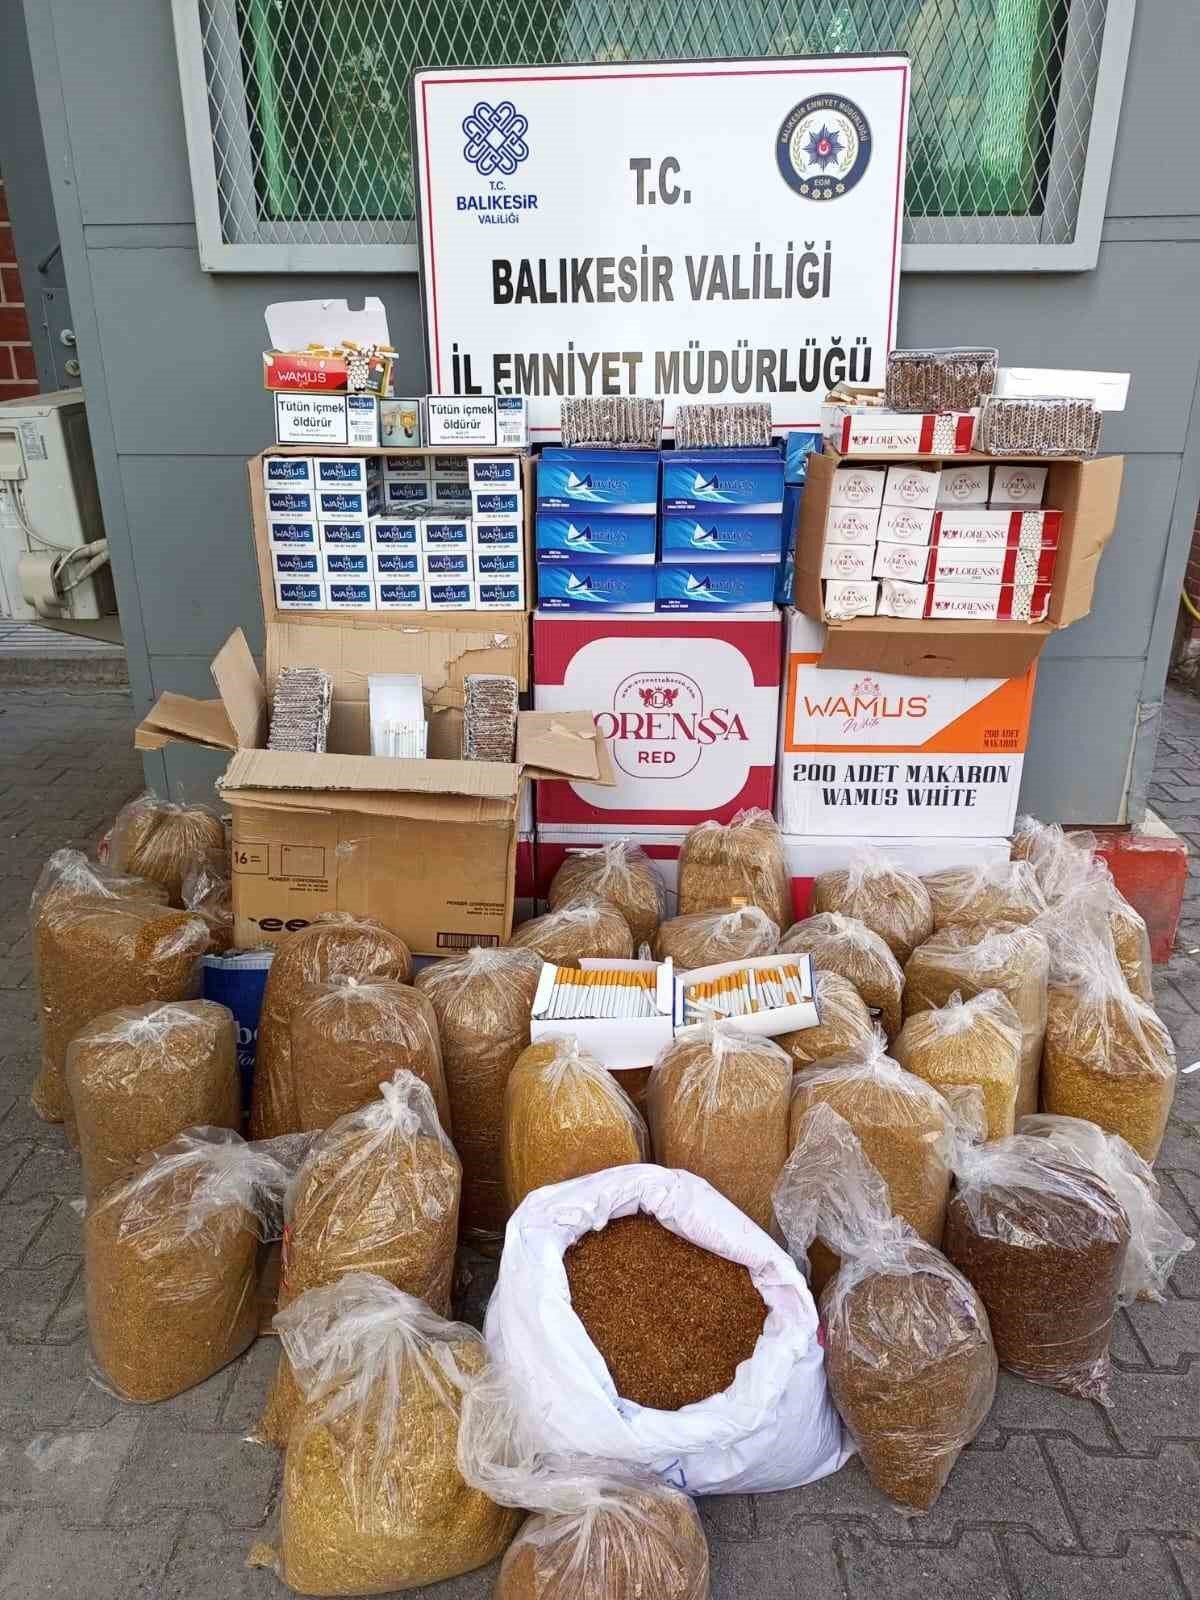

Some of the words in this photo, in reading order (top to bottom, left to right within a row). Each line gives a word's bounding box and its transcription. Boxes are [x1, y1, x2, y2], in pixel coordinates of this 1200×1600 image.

[488, 180, 507, 191] T.C.
[629, 156, 692, 205] T.C.
[491, 244, 674, 304] BALIKESİR
[685, 240, 832, 301] VALİLİĞİ
[452, 342, 482, 395] İL
[493, 341, 643, 395] EMNİYET
[655, 335, 873, 395] MÜDÜRLÜĞÜ
[277, 370, 327, 383] WAMUS
[279, 399, 310, 413] Tütün
[313, 401, 345, 415] içmek
[430, 404, 460, 415] Tütün
[463, 404, 494, 417] içmek
[293, 416, 333, 428] öldürür
[443, 418, 481, 430] öldürür
[270, 468, 306, 477] WAMUS
[321, 469, 358, 478] WAMUS
[476, 470, 512, 478] WAMUS
[271, 499, 308, 509] WAMUS
[322, 500, 359, 509] WAMUS
[479, 500, 514, 509] WAMUS
[274, 530, 310, 539] WAMUS
[326, 530, 362, 540] WAMUS
[377, 530, 413, 540] WAMUS
[428, 530, 464, 539] WAMUS
[479, 531, 514, 540] WAMUS
[279, 560, 314, 569] WAMUS
[329, 560, 365, 570] WAMUS
[380, 560, 415, 570] WAMUS
[430, 560, 465, 569] WAMUS
[480, 560, 516, 570] WAMUS
[282, 590, 318, 599] WAMUS
[332, 590, 368, 599] WAMUS
[382, 590, 417, 599] WAMUS
[432, 590, 467, 600] WAMUS
[482, 590, 516, 599] WAMUS
[803, 696, 929, 718] WAMUS
[592, 704, 749, 745] ORENSSA
[637, 751, 677, 764] RED
[793, 764, 836, 783] 200
[844, 764, 900, 783] ADET
[905, 764, 1011, 784] MAKARON
[821, 787, 898, 806] WAMUS
[234, 851, 248, 864] 16
